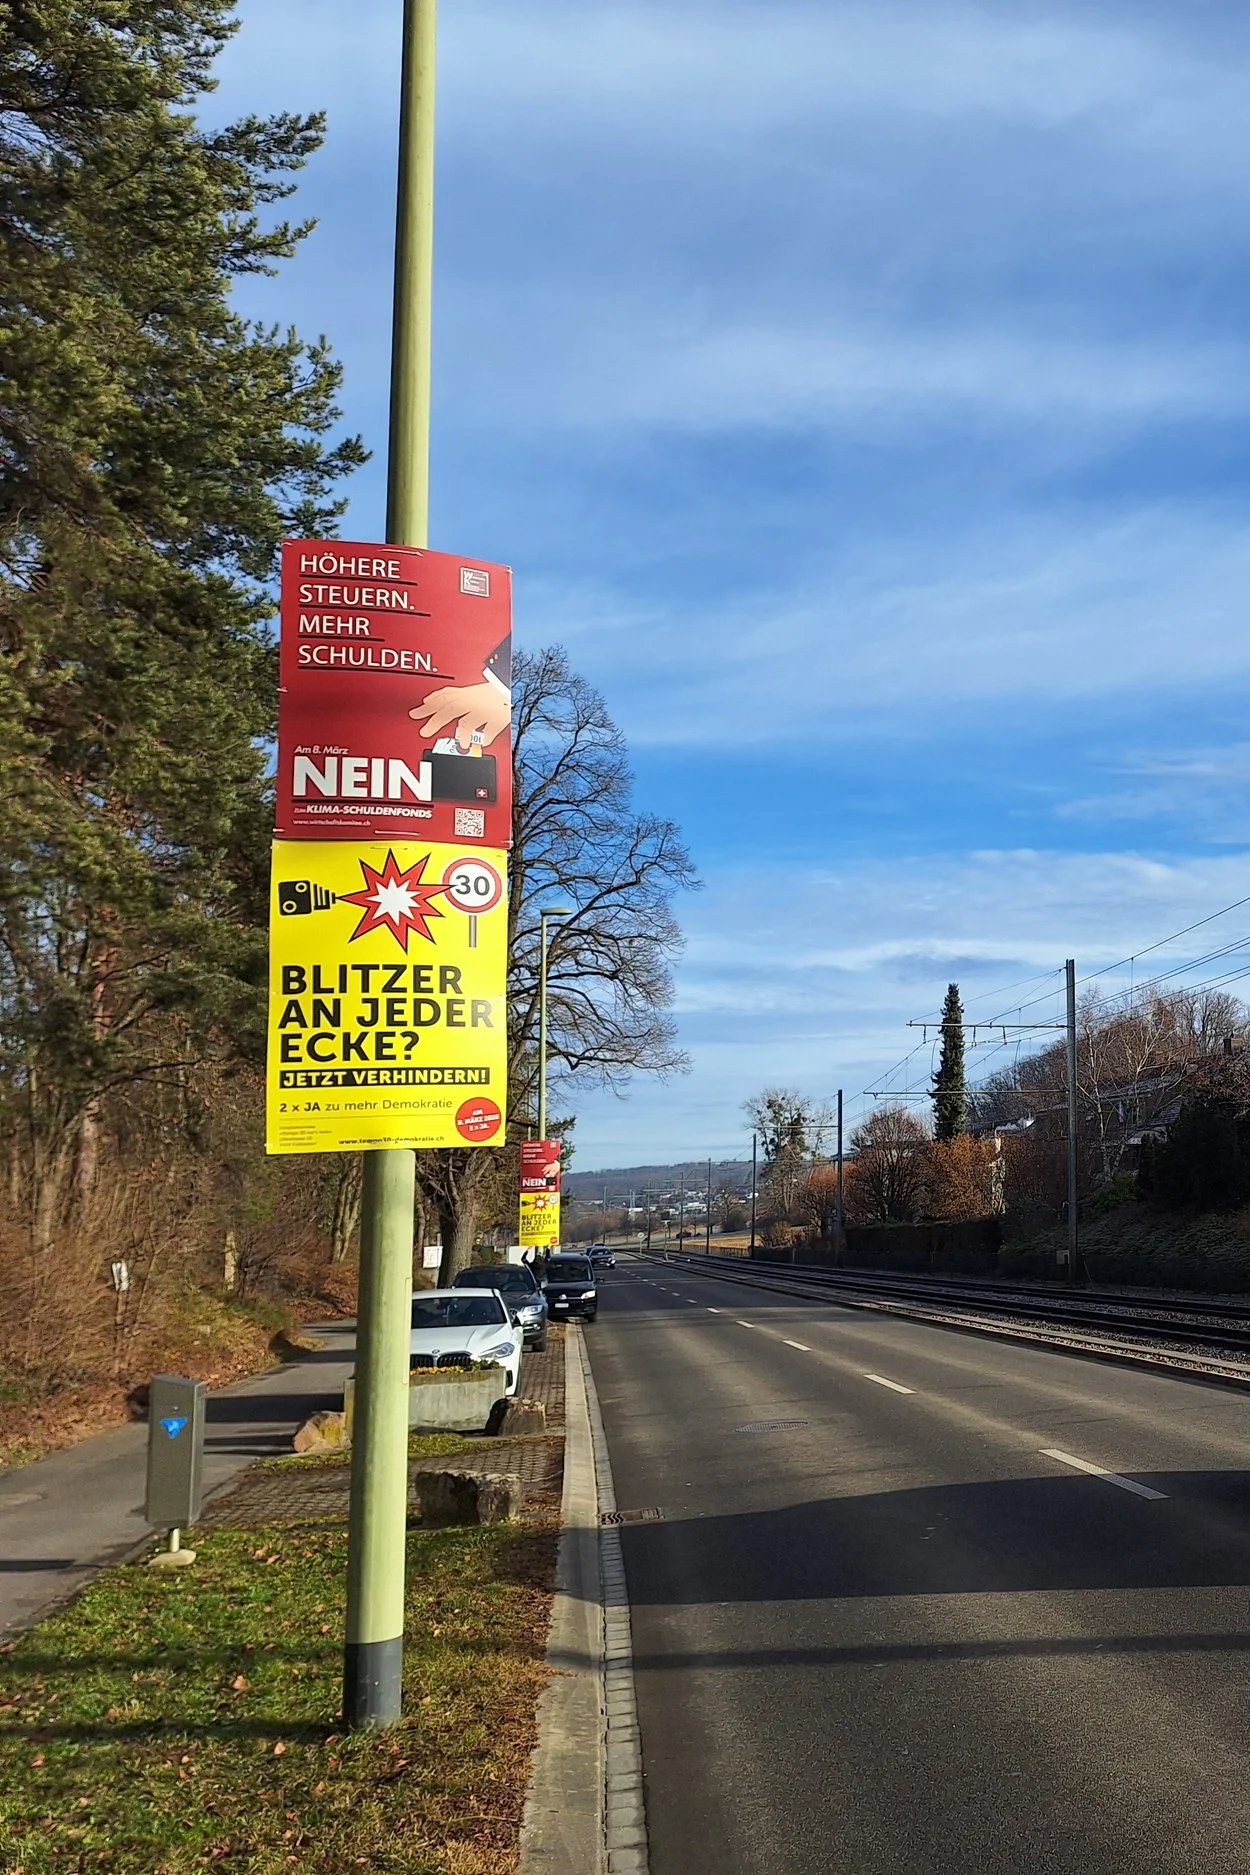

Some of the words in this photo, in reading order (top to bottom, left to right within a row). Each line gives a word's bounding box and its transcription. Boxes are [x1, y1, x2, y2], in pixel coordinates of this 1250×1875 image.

[300, 553, 400, 579] HÖHERE
[299, 584, 416, 610] STEUERN.
[299, 614, 370, 636] MEHR
[298, 645, 438, 673] SCHULDEN.
[294, 745, 311, 754] Am
[312, 746, 321, 754] 8.
[323, 746, 349, 755] März
[293, 756, 433, 801] NEIN
[306, 804, 433, 819] KLIMA-SCHULDENFONDS
[455, 874, 490, 897] 30
[281, 964, 463, 995] BLITZER
[278, 999, 341, 1029] AN
[356, 998, 494, 1028] JEDER
[280, 1031, 420, 1063] ECKE?
[283, 1071, 347, 1087] JETZT
[352, 1069, 486, 1085] VERHINDERN!
[280, 1103, 287, 1112] 2
[292, 1104, 300, 1112] x
[304, 1102, 320, 1111] JA
[344, 1100, 378, 1110] mehr
[382, 1098, 453, 1109] Demokratie
[522, 1178, 547, 1187] NEIN
[521, 1213, 551, 1221] BLITZER
